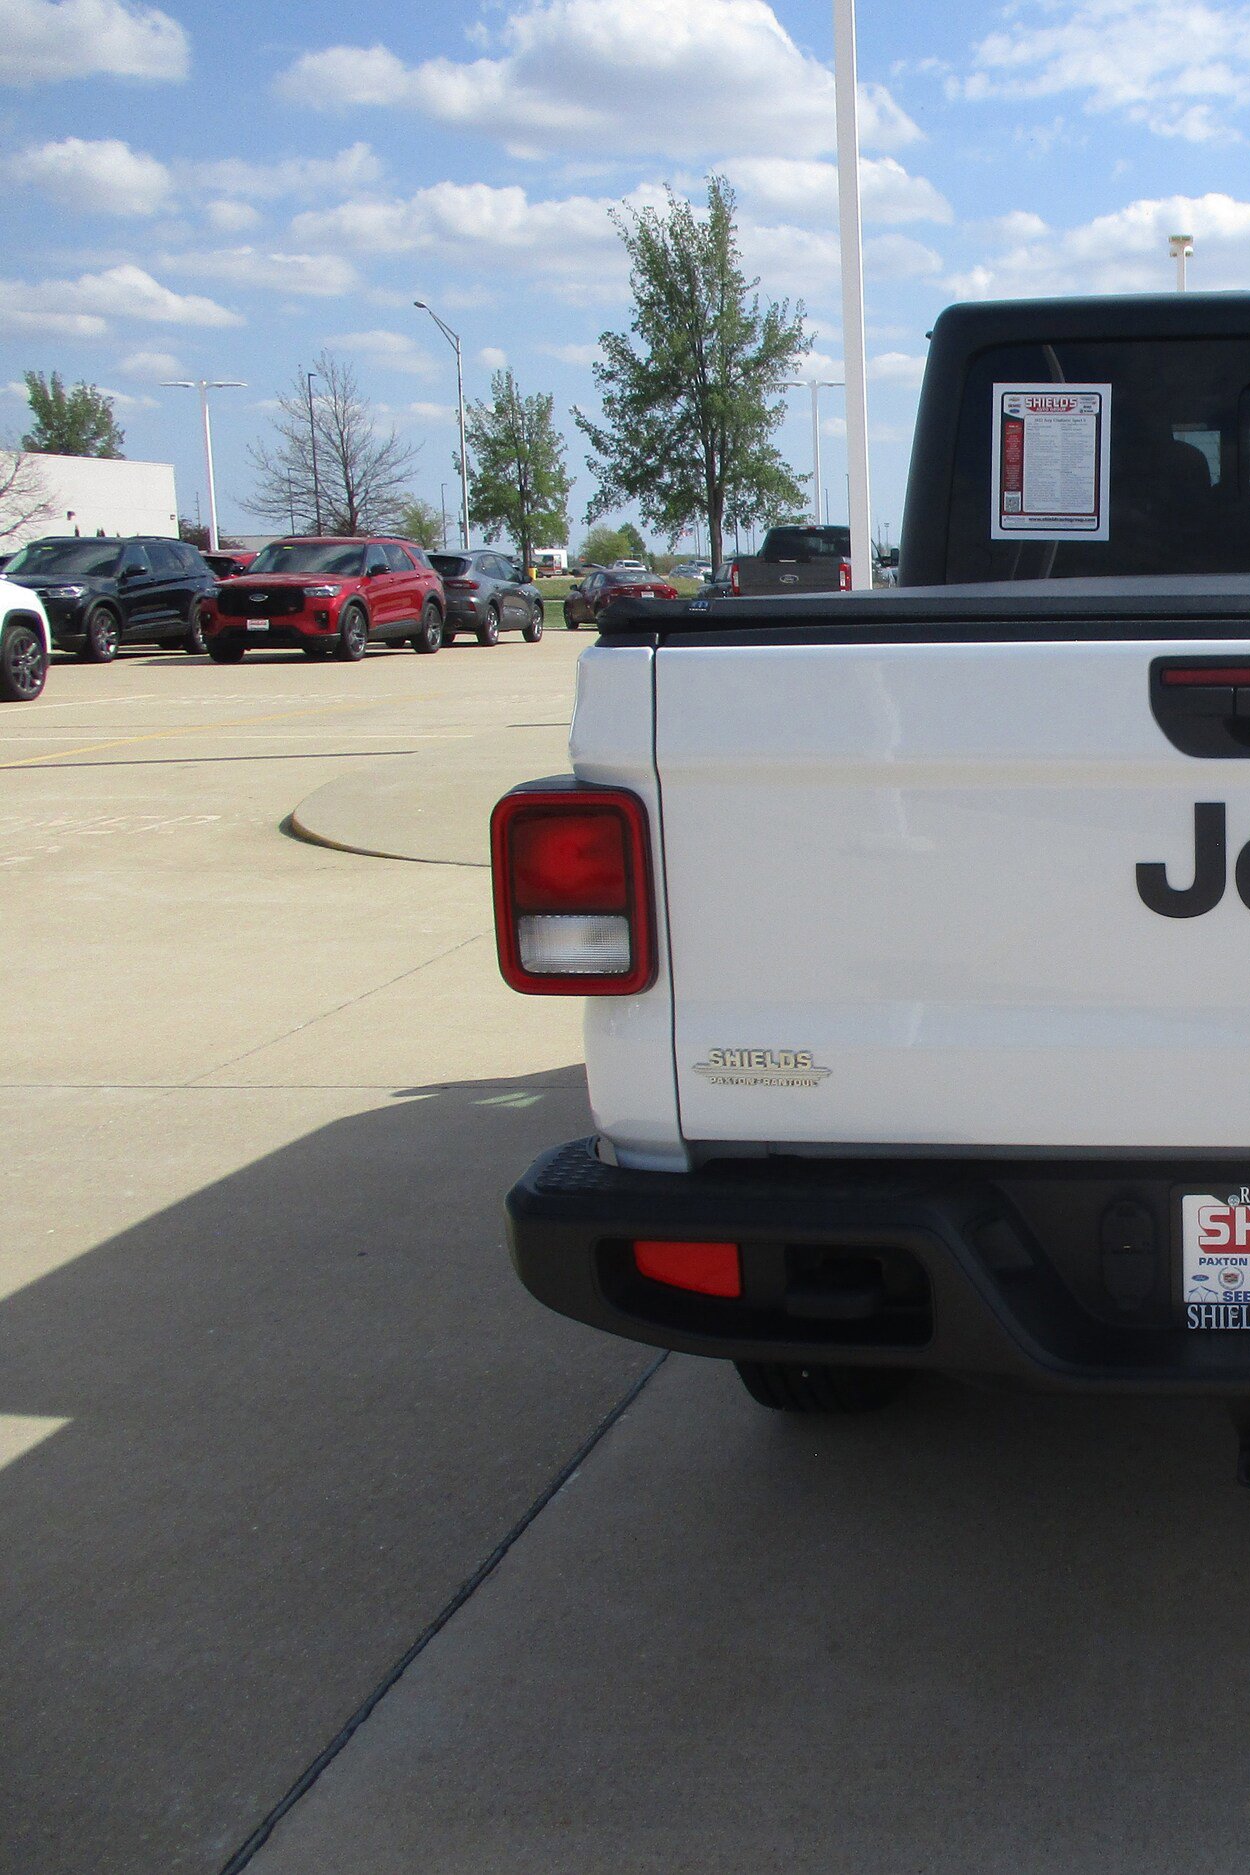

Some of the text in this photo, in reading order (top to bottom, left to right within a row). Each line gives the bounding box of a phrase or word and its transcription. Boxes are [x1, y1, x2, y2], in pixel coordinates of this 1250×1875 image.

[1025, 397, 1077, 408] SHIELDS
[708, 1048, 813, 1070] SHIELDS
[1199, 1258, 1248, 1266] PAXTON
